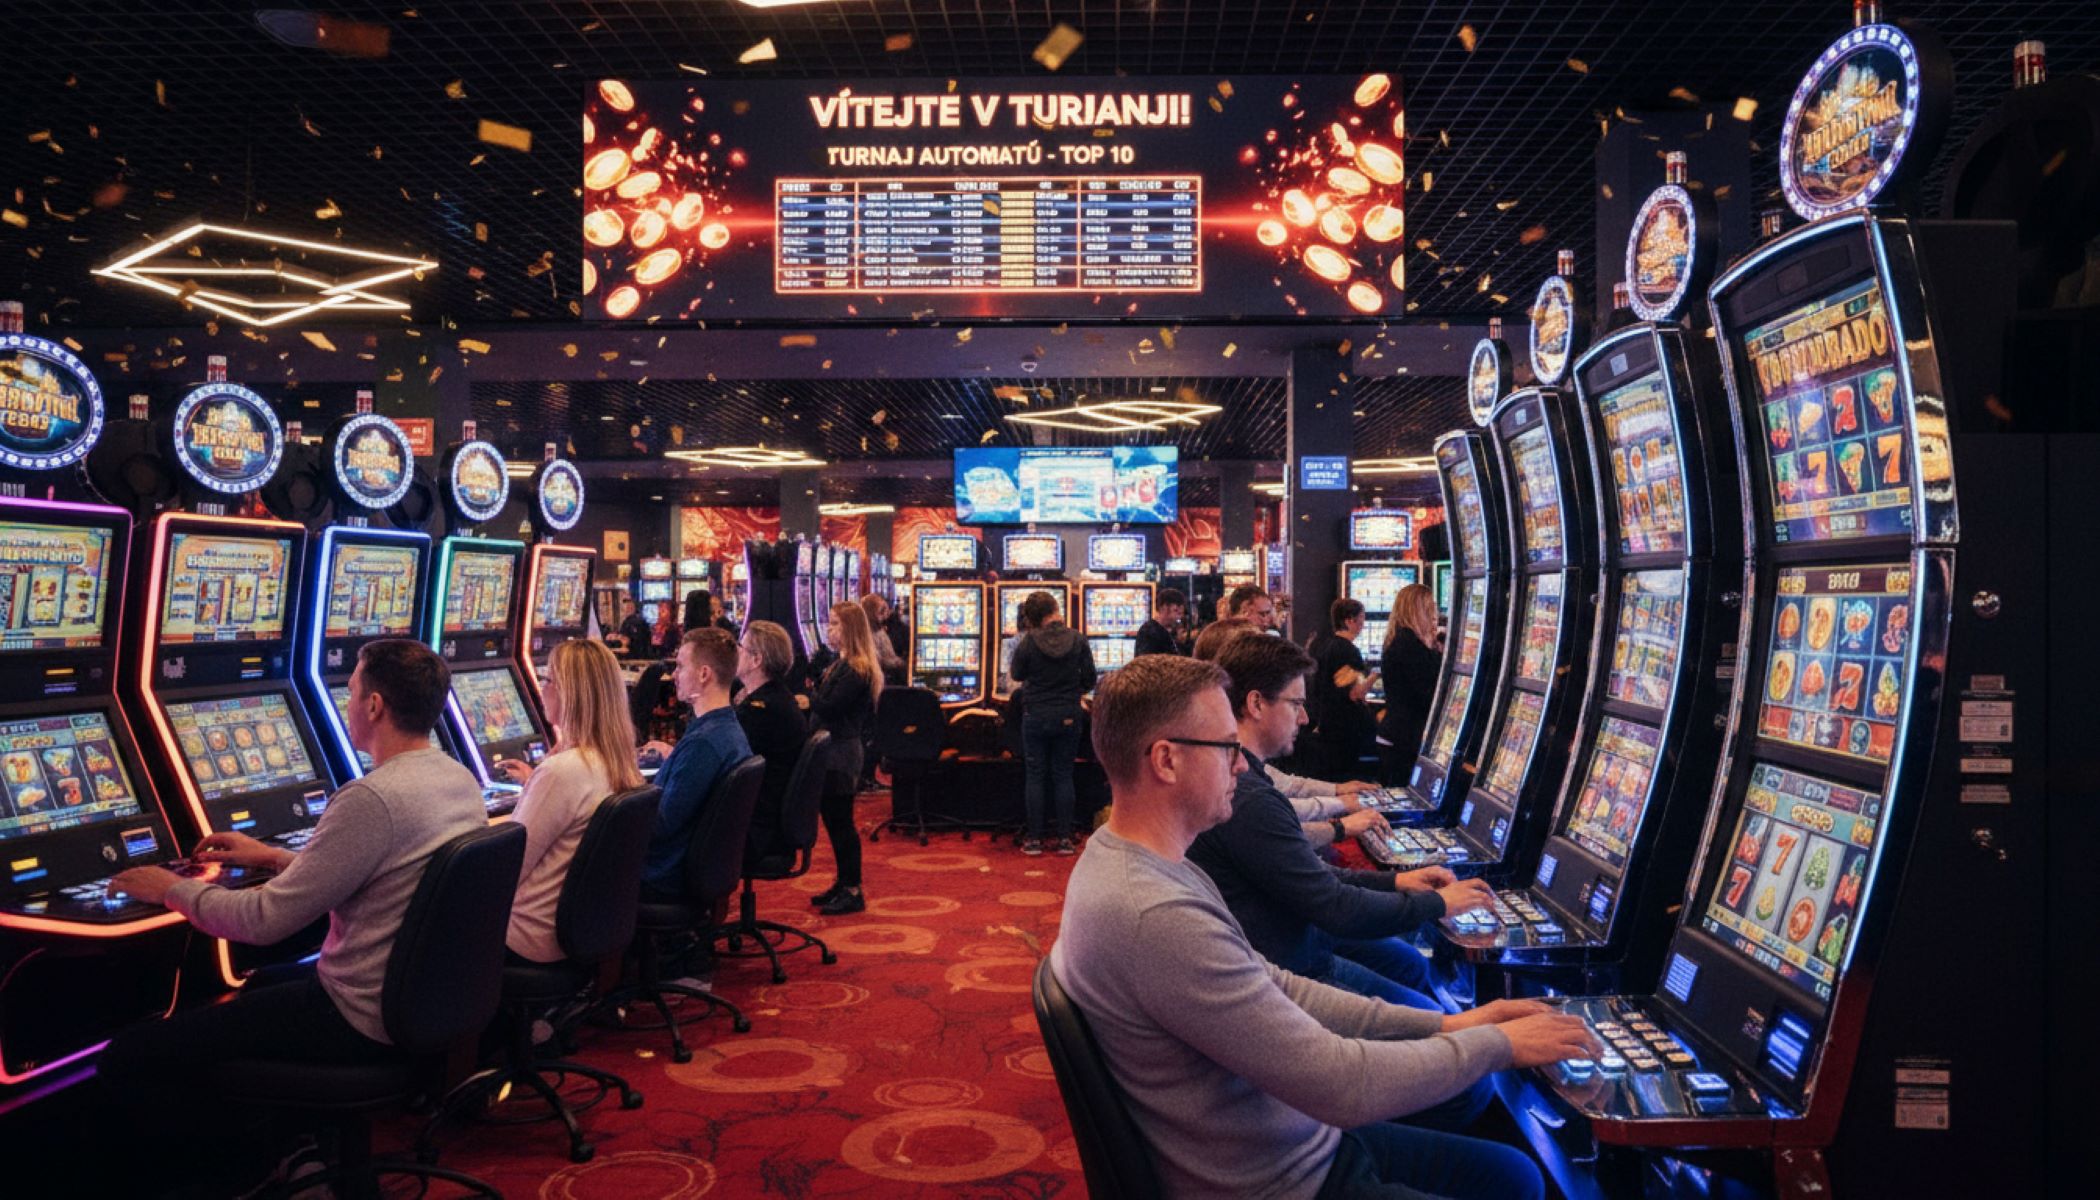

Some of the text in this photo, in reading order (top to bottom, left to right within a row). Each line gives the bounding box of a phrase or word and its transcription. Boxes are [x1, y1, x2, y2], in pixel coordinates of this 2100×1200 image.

[809, 87, 1190, 127] VÍTEJTE V TURIANJI!
[828, 147, 914, 166] TURNAJ
[1059, 146, 1104, 165] TOP
[1110, 145, 1135, 164] 10
